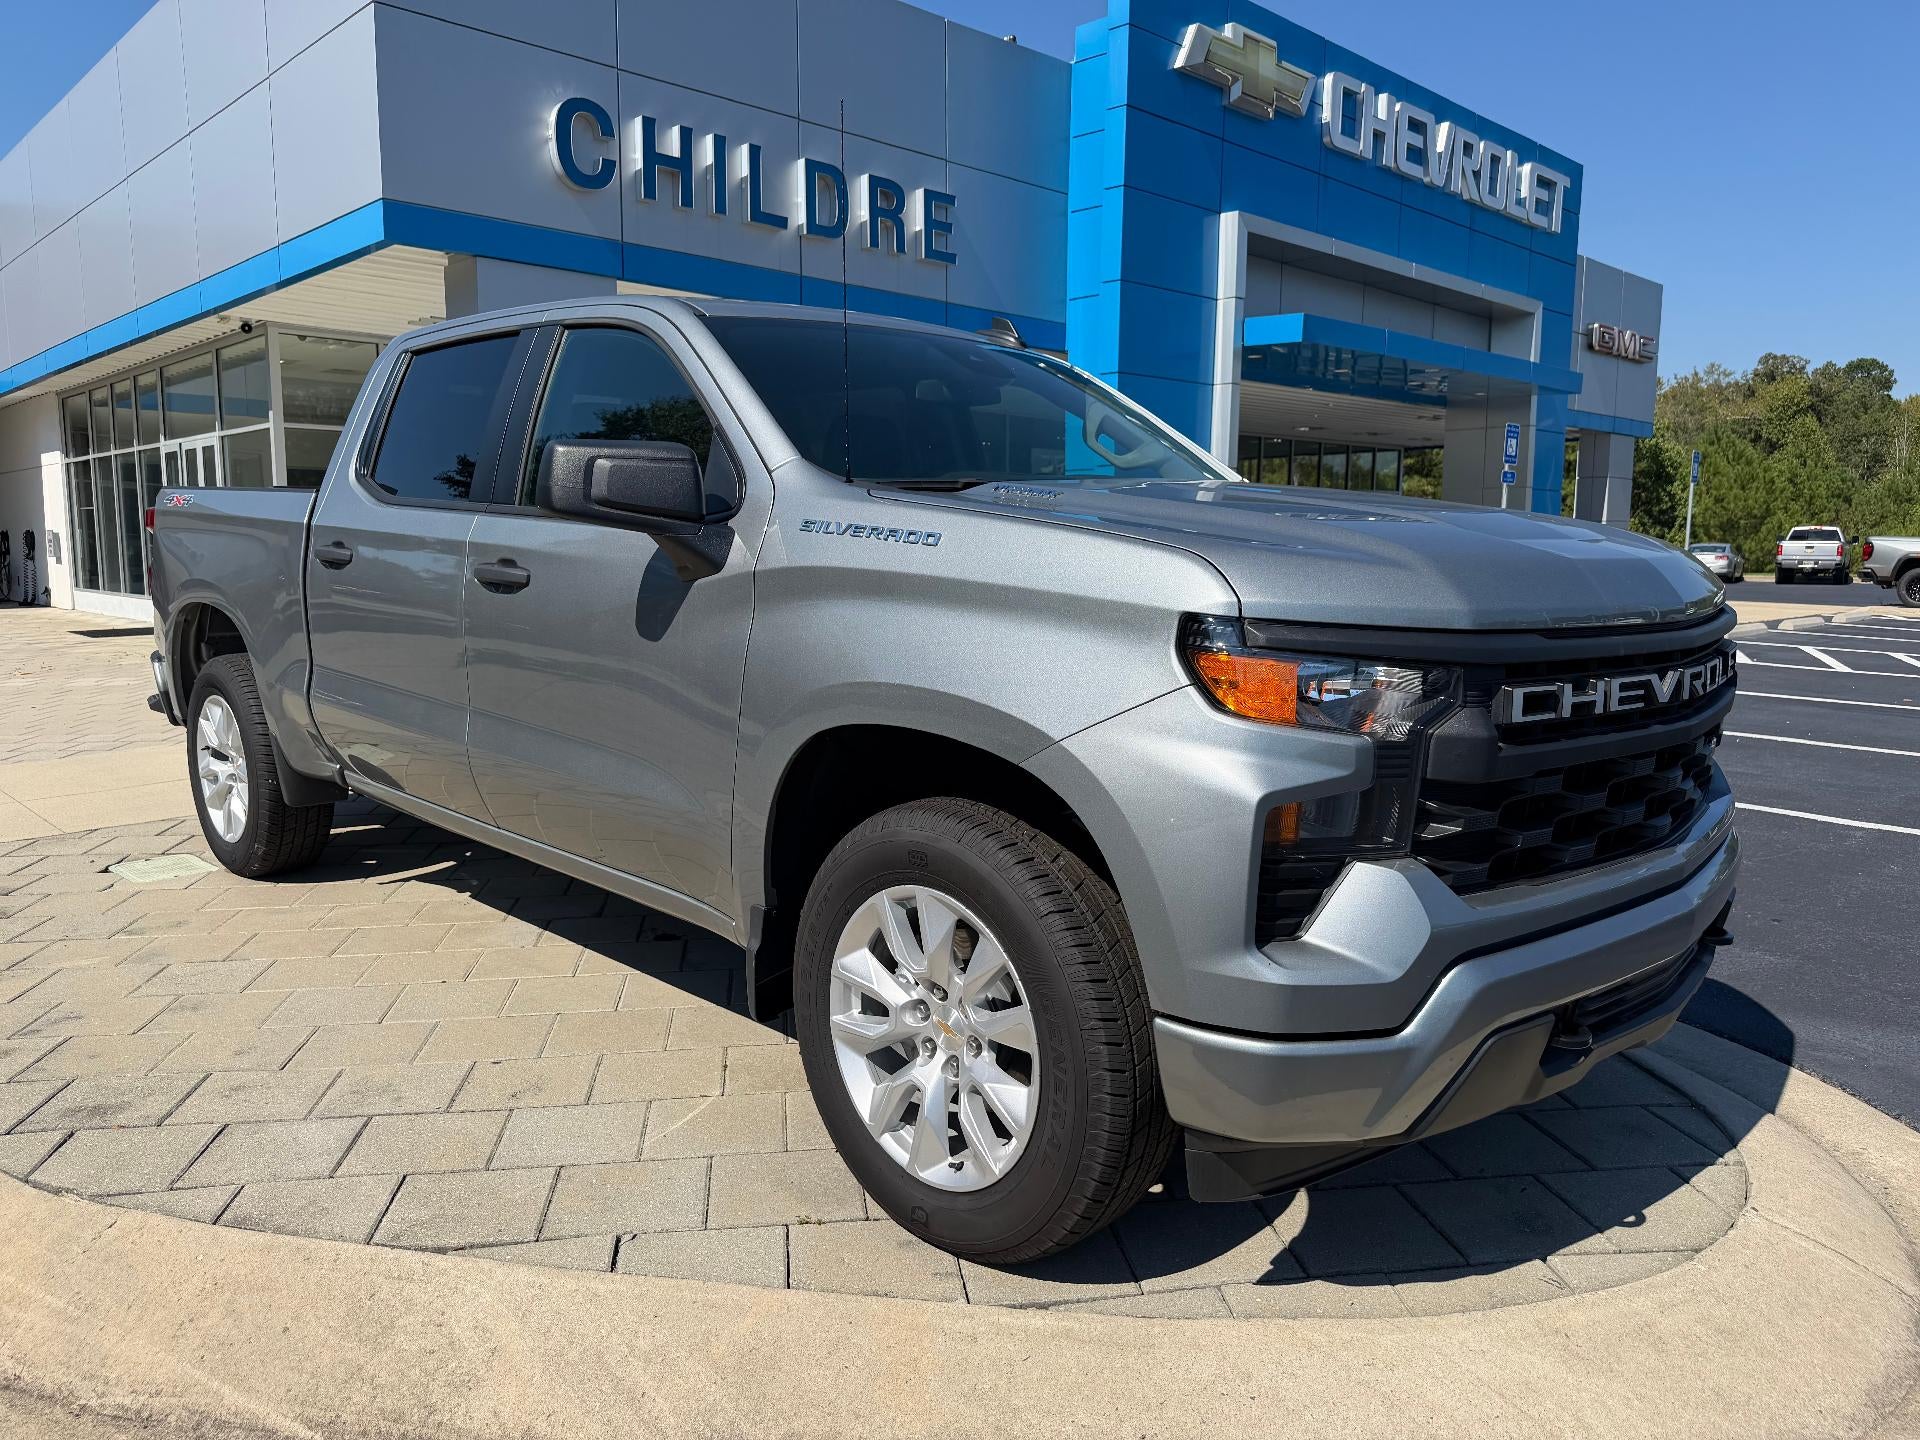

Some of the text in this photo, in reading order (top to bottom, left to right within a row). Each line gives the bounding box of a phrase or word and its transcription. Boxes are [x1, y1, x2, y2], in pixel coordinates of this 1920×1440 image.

[549, 97, 957, 265] CHILDRE
[1322, 71, 1570, 234] CHEVROLET
[1591, 323, 1657, 362] GMC
[799, 518, 942, 547] SILVERADO
[1502, 650, 1737, 724] CHEVROLE
